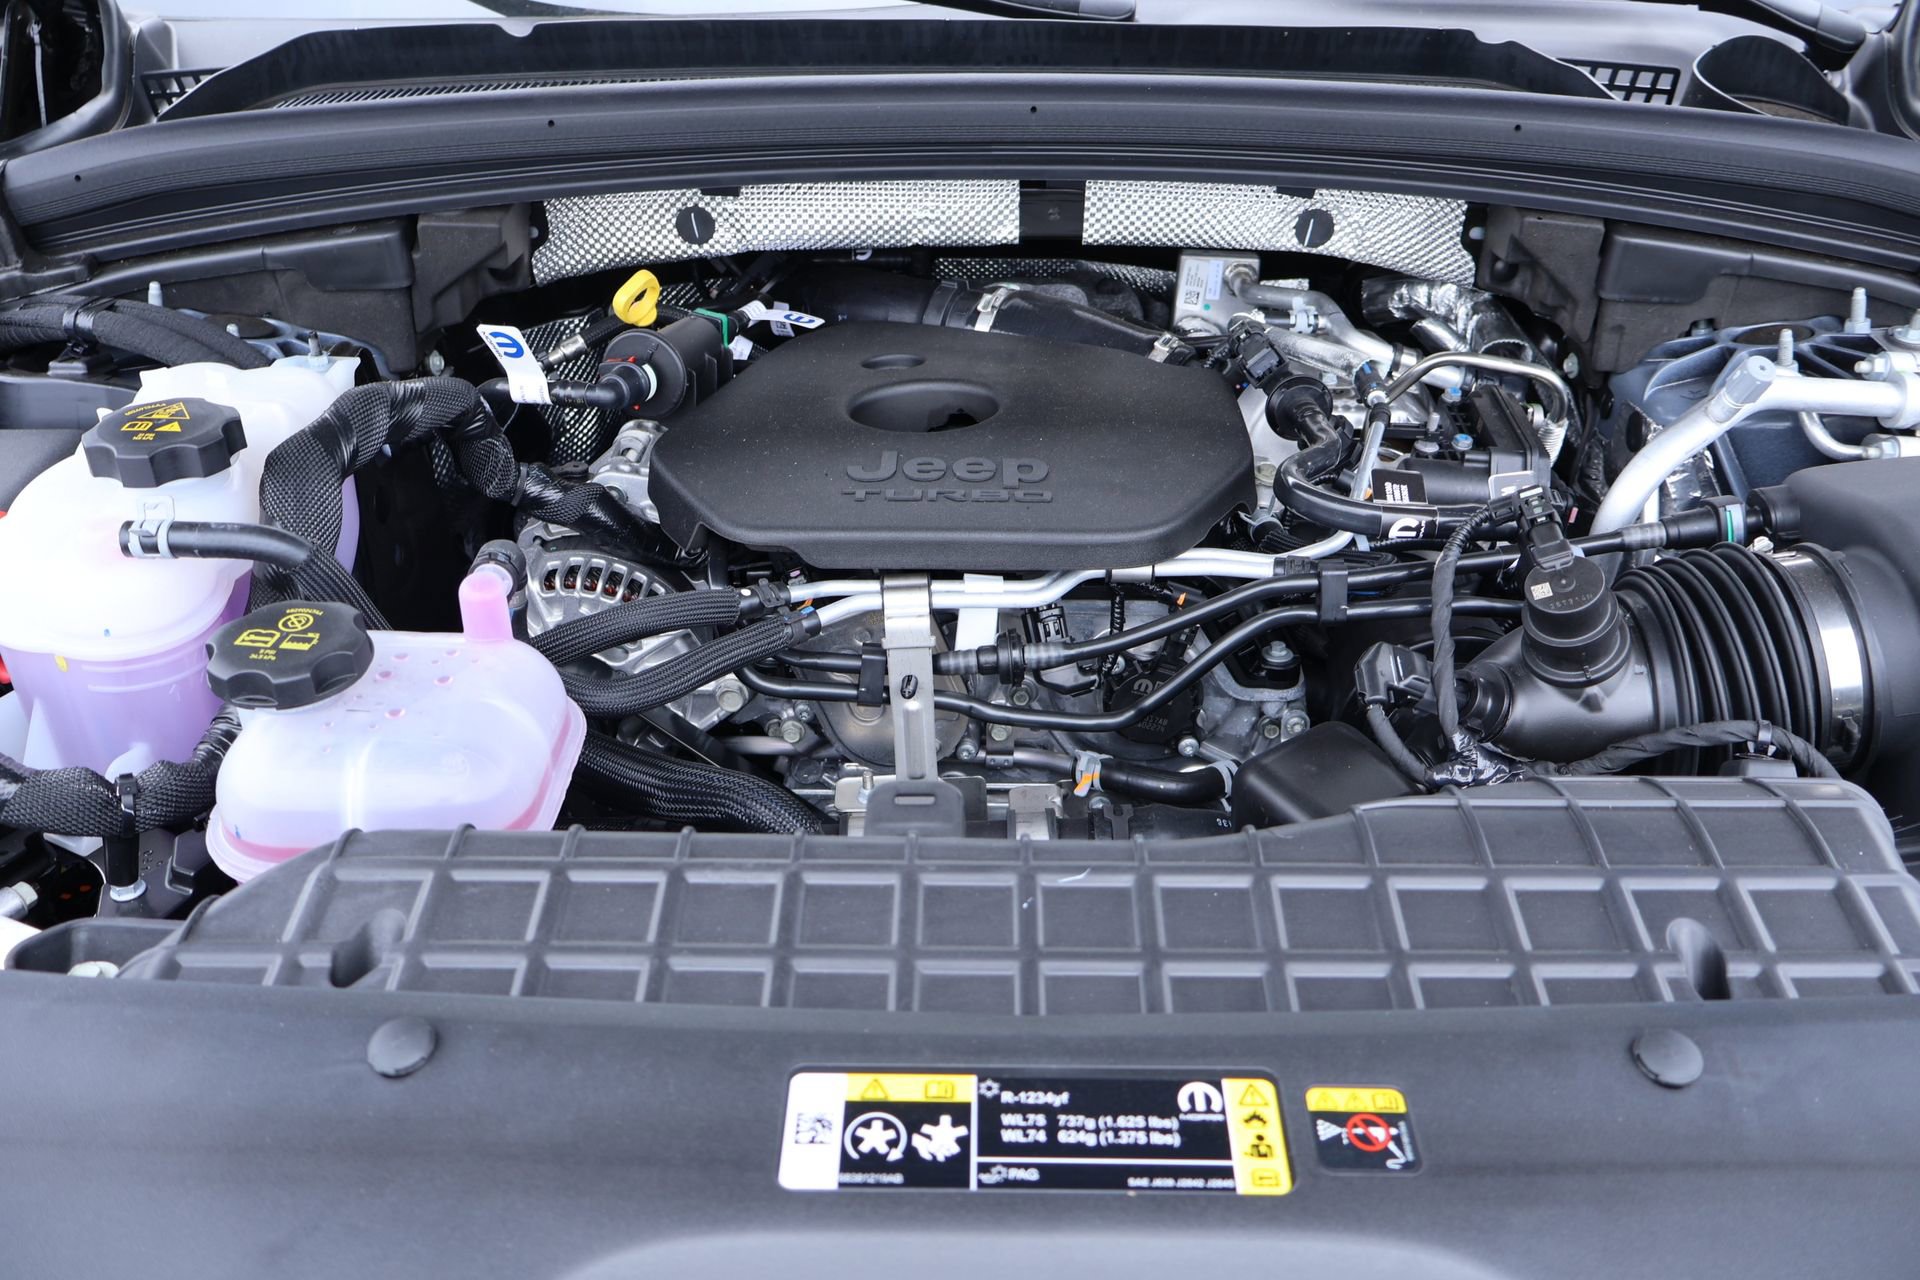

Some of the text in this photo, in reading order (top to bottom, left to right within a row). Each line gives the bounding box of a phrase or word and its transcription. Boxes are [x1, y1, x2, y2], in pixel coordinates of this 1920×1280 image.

[845, 450, 1050, 489] Jeep
[840, 488, 1054, 503] TURBO
[1000, 1090, 1070, 1108] R-1234yf
[1056, 1114, 1097, 1131] 737g
[1147, 1115, 1180, 1131] lbs)
[1148, 1130, 1181, 1148] lbs)
[1007, 1167, 1041, 1182] PAG
